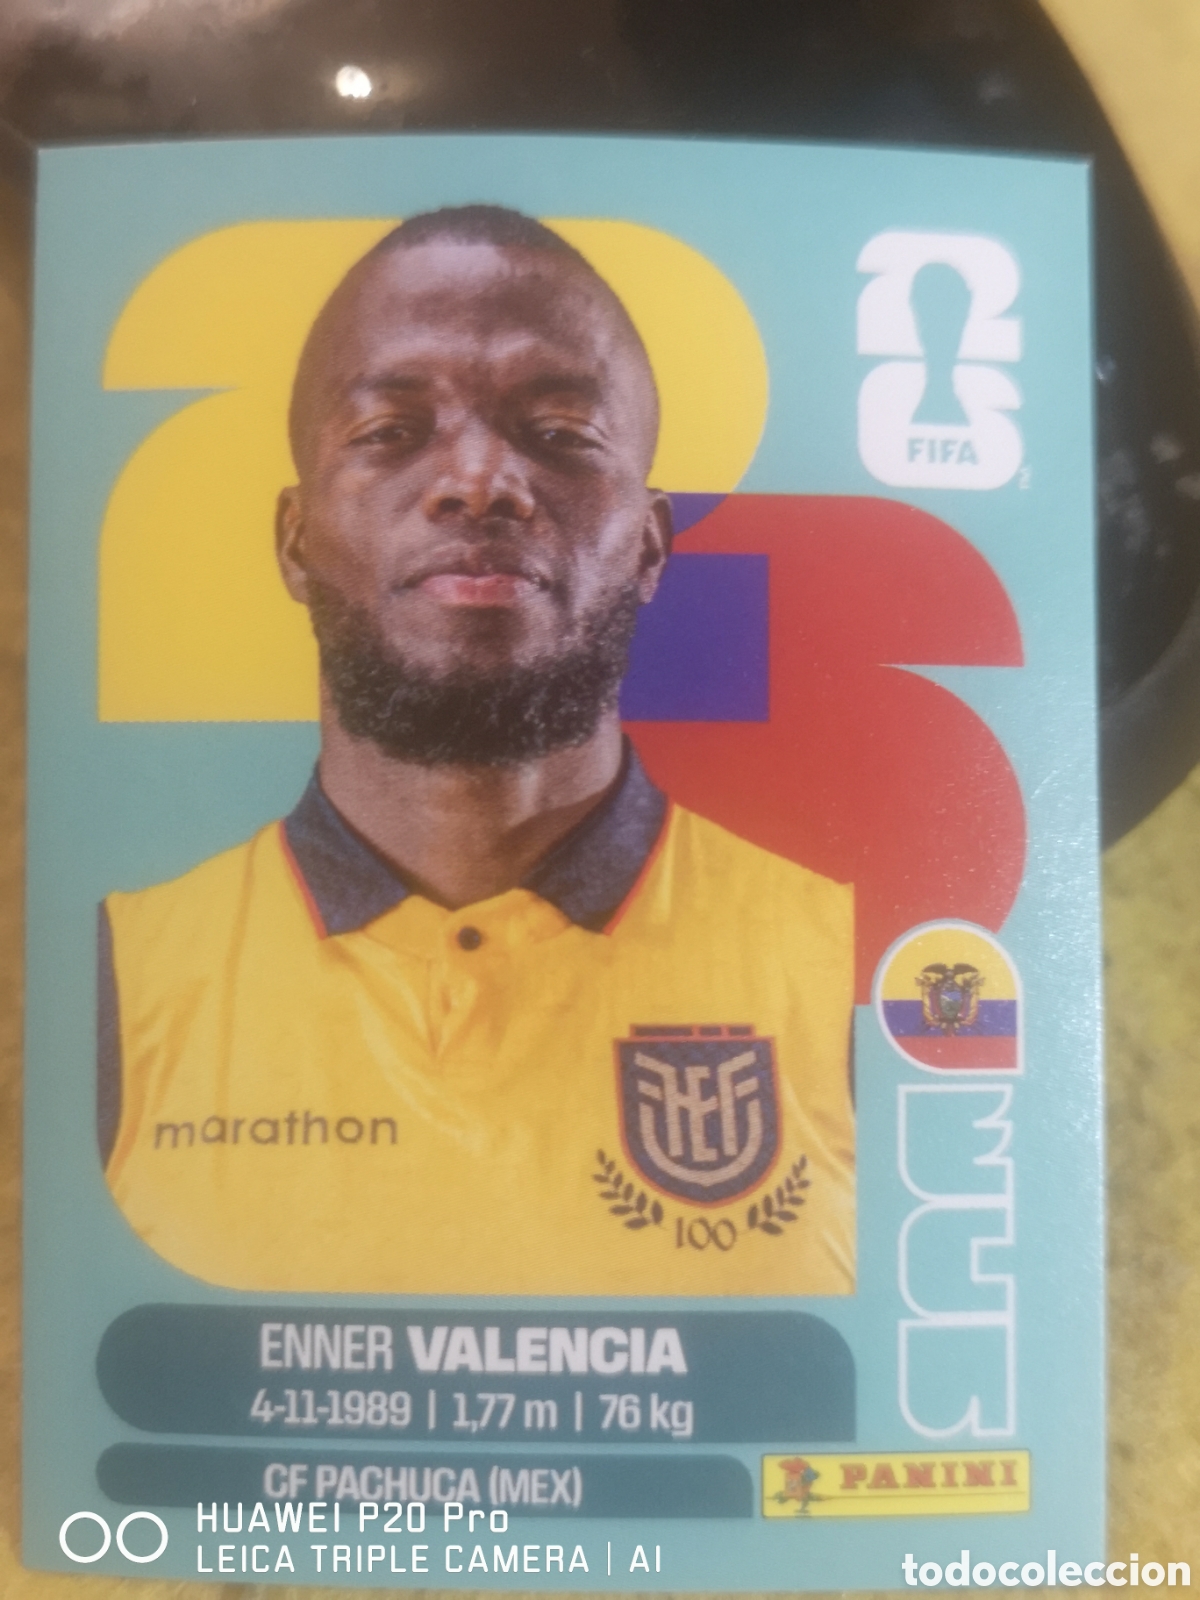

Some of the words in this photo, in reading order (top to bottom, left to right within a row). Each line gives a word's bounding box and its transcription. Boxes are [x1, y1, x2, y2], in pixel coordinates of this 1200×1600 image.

[906, 437, 978, 465] FIFA
[153, 1110, 399, 1150] marathon
[675, 1216, 738, 1251] 100
[259, 1322, 394, 1371] ENNER
[406, 1325, 688, 1374] VALENCIA
[250, 1389, 411, 1428] 4-11-1989
[451, 1393, 516, 1433] 1,77
[523, 1399, 558, 1430] m
[599, 1394, 642, 1430] 76
[649, 1393, 694, 1437] kg
[263, 1462, 308, 1499] CF
[314, 1465, 481, 1503] PACHUCA
[488, 1465, 583, 1510] (MEX)
[839, 1459, 1018, 1490] PANINI
